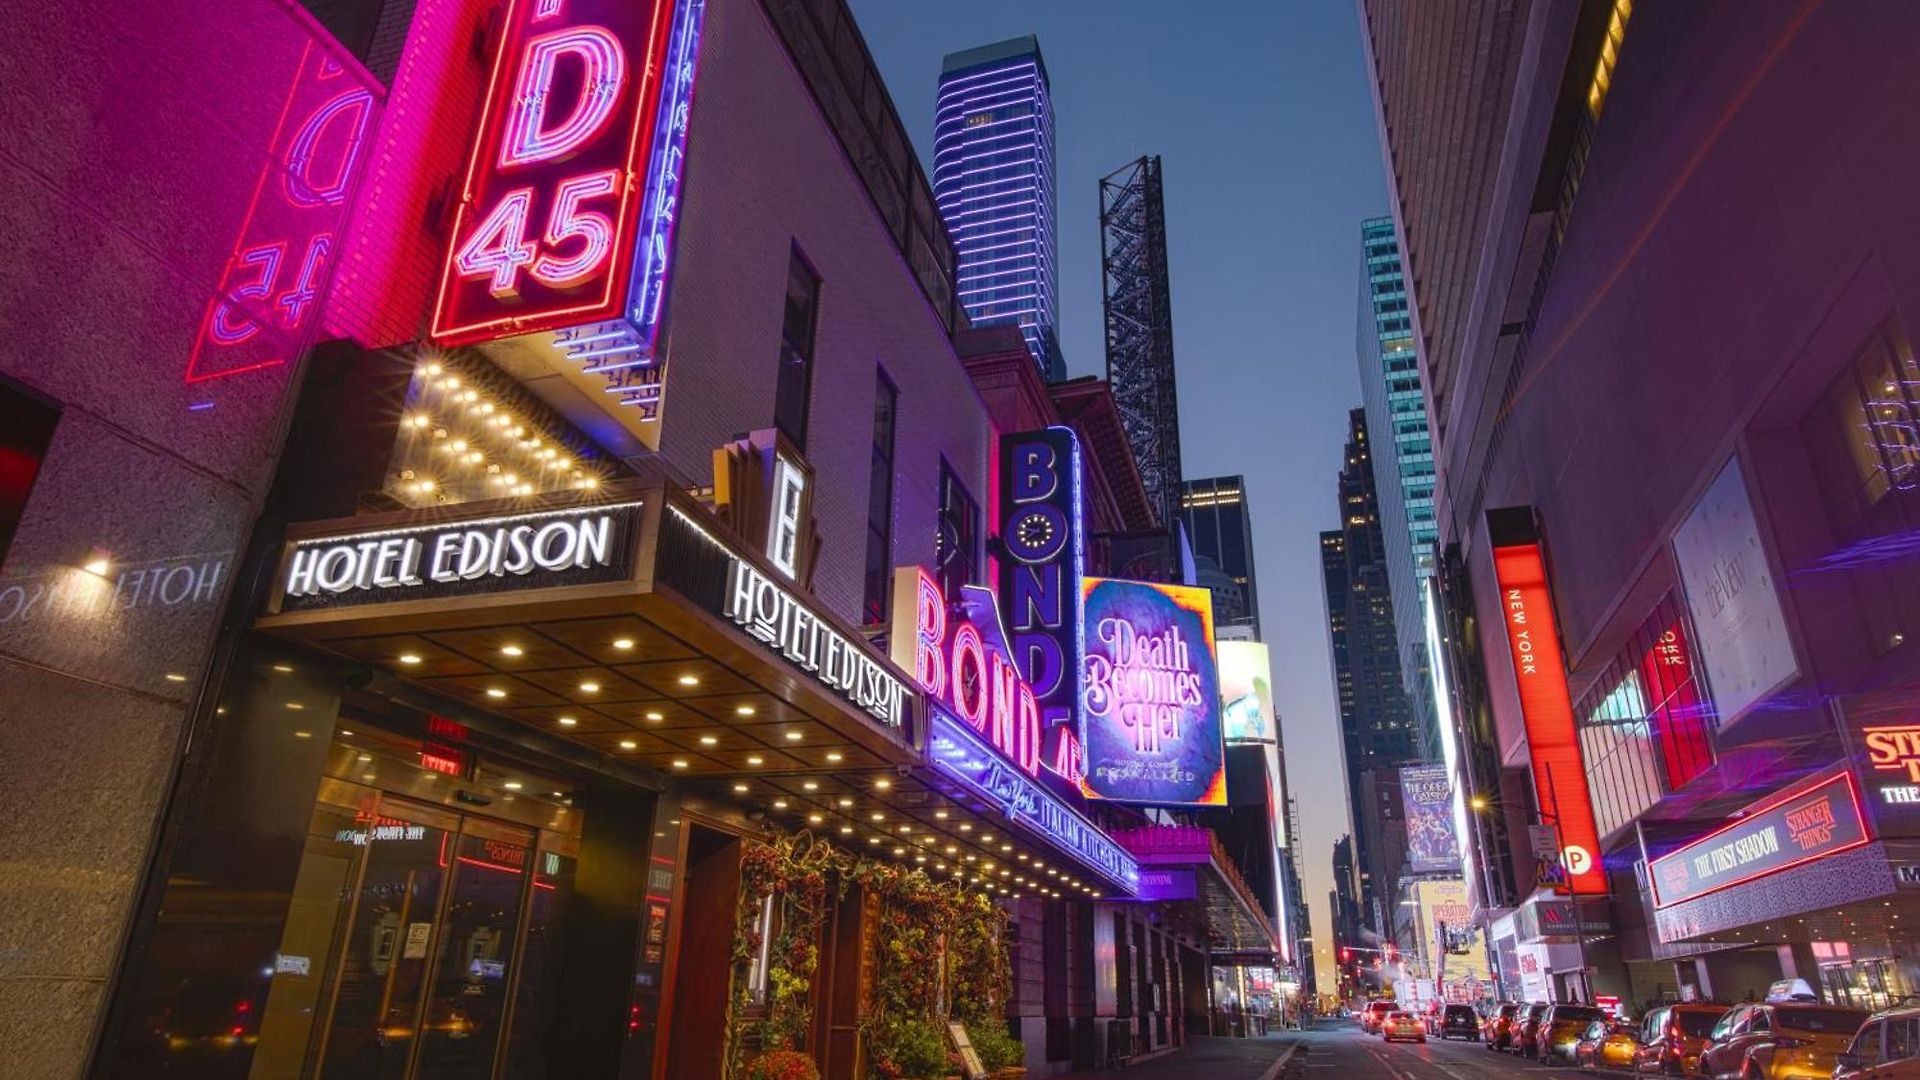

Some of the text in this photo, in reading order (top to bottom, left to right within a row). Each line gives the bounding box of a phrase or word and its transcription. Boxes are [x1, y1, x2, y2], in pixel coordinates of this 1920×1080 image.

[454, 168, 621, 299] 45
[286, 516, 614, 598] HOTEL EDISON
[1004, 440, 1068, 698] BOND
[724, 559, 914, 728] HOTEL EDISON
[1099, 617, 1191, 672] Death
[1508, 589, 1537, 675] NEW YORK
[914, 566, 1040, 778] BOND
[1084, 654, 1202, 717] Becomes
[1120, 700, 1184, 755] Her
[1785, 798, 1836, 838] STRANGER
[1799, 826, 1832, 851] THINGS
[1569, 851, 1583, 869] P
[1694, 853, 1714, 879] THE
[1711, 842, 1738, 874] FIRST
[1734, 825, 1779, 865] SHADOW
